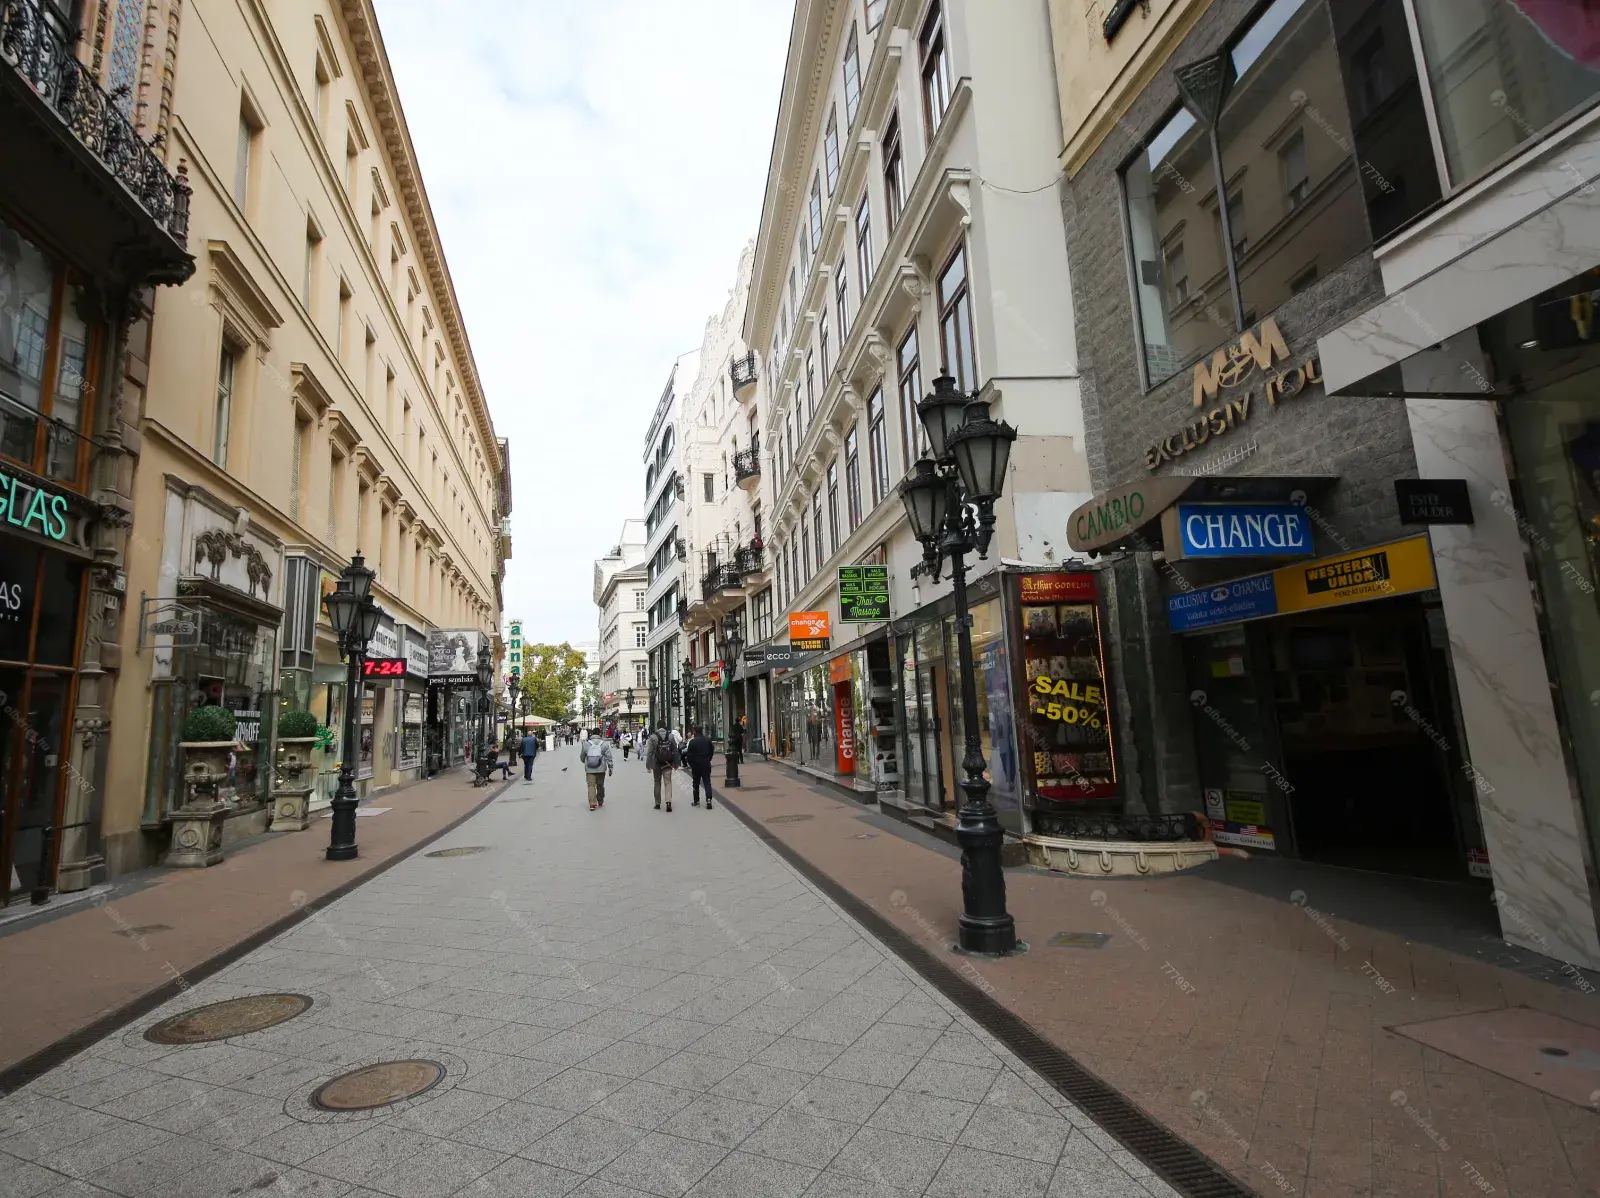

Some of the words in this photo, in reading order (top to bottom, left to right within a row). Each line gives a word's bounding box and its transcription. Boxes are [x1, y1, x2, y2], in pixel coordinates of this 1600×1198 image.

[1076, 491, 1145, 542] CAMBIO
[1186, 512, 1304, 549] CHANGE
[1306, 557, 1373, 581] WESTERN
[1327, 569, 1376, 589] UNION
[856, 595, 874, 607] Thai
[1168, 590, 1209, 612] EXCLUSIVE
[1231, 577, 1272, 597] CHANGE
[849, 605, 881, 619] Massage
[791, 619, 816, 628] change
[766, 652, 791, 660] ecco
[364, 661, 404, 675] 7-24
[1035, 675, 1100, 705] SALE
[1036, 702, 1101, 729] -50%
